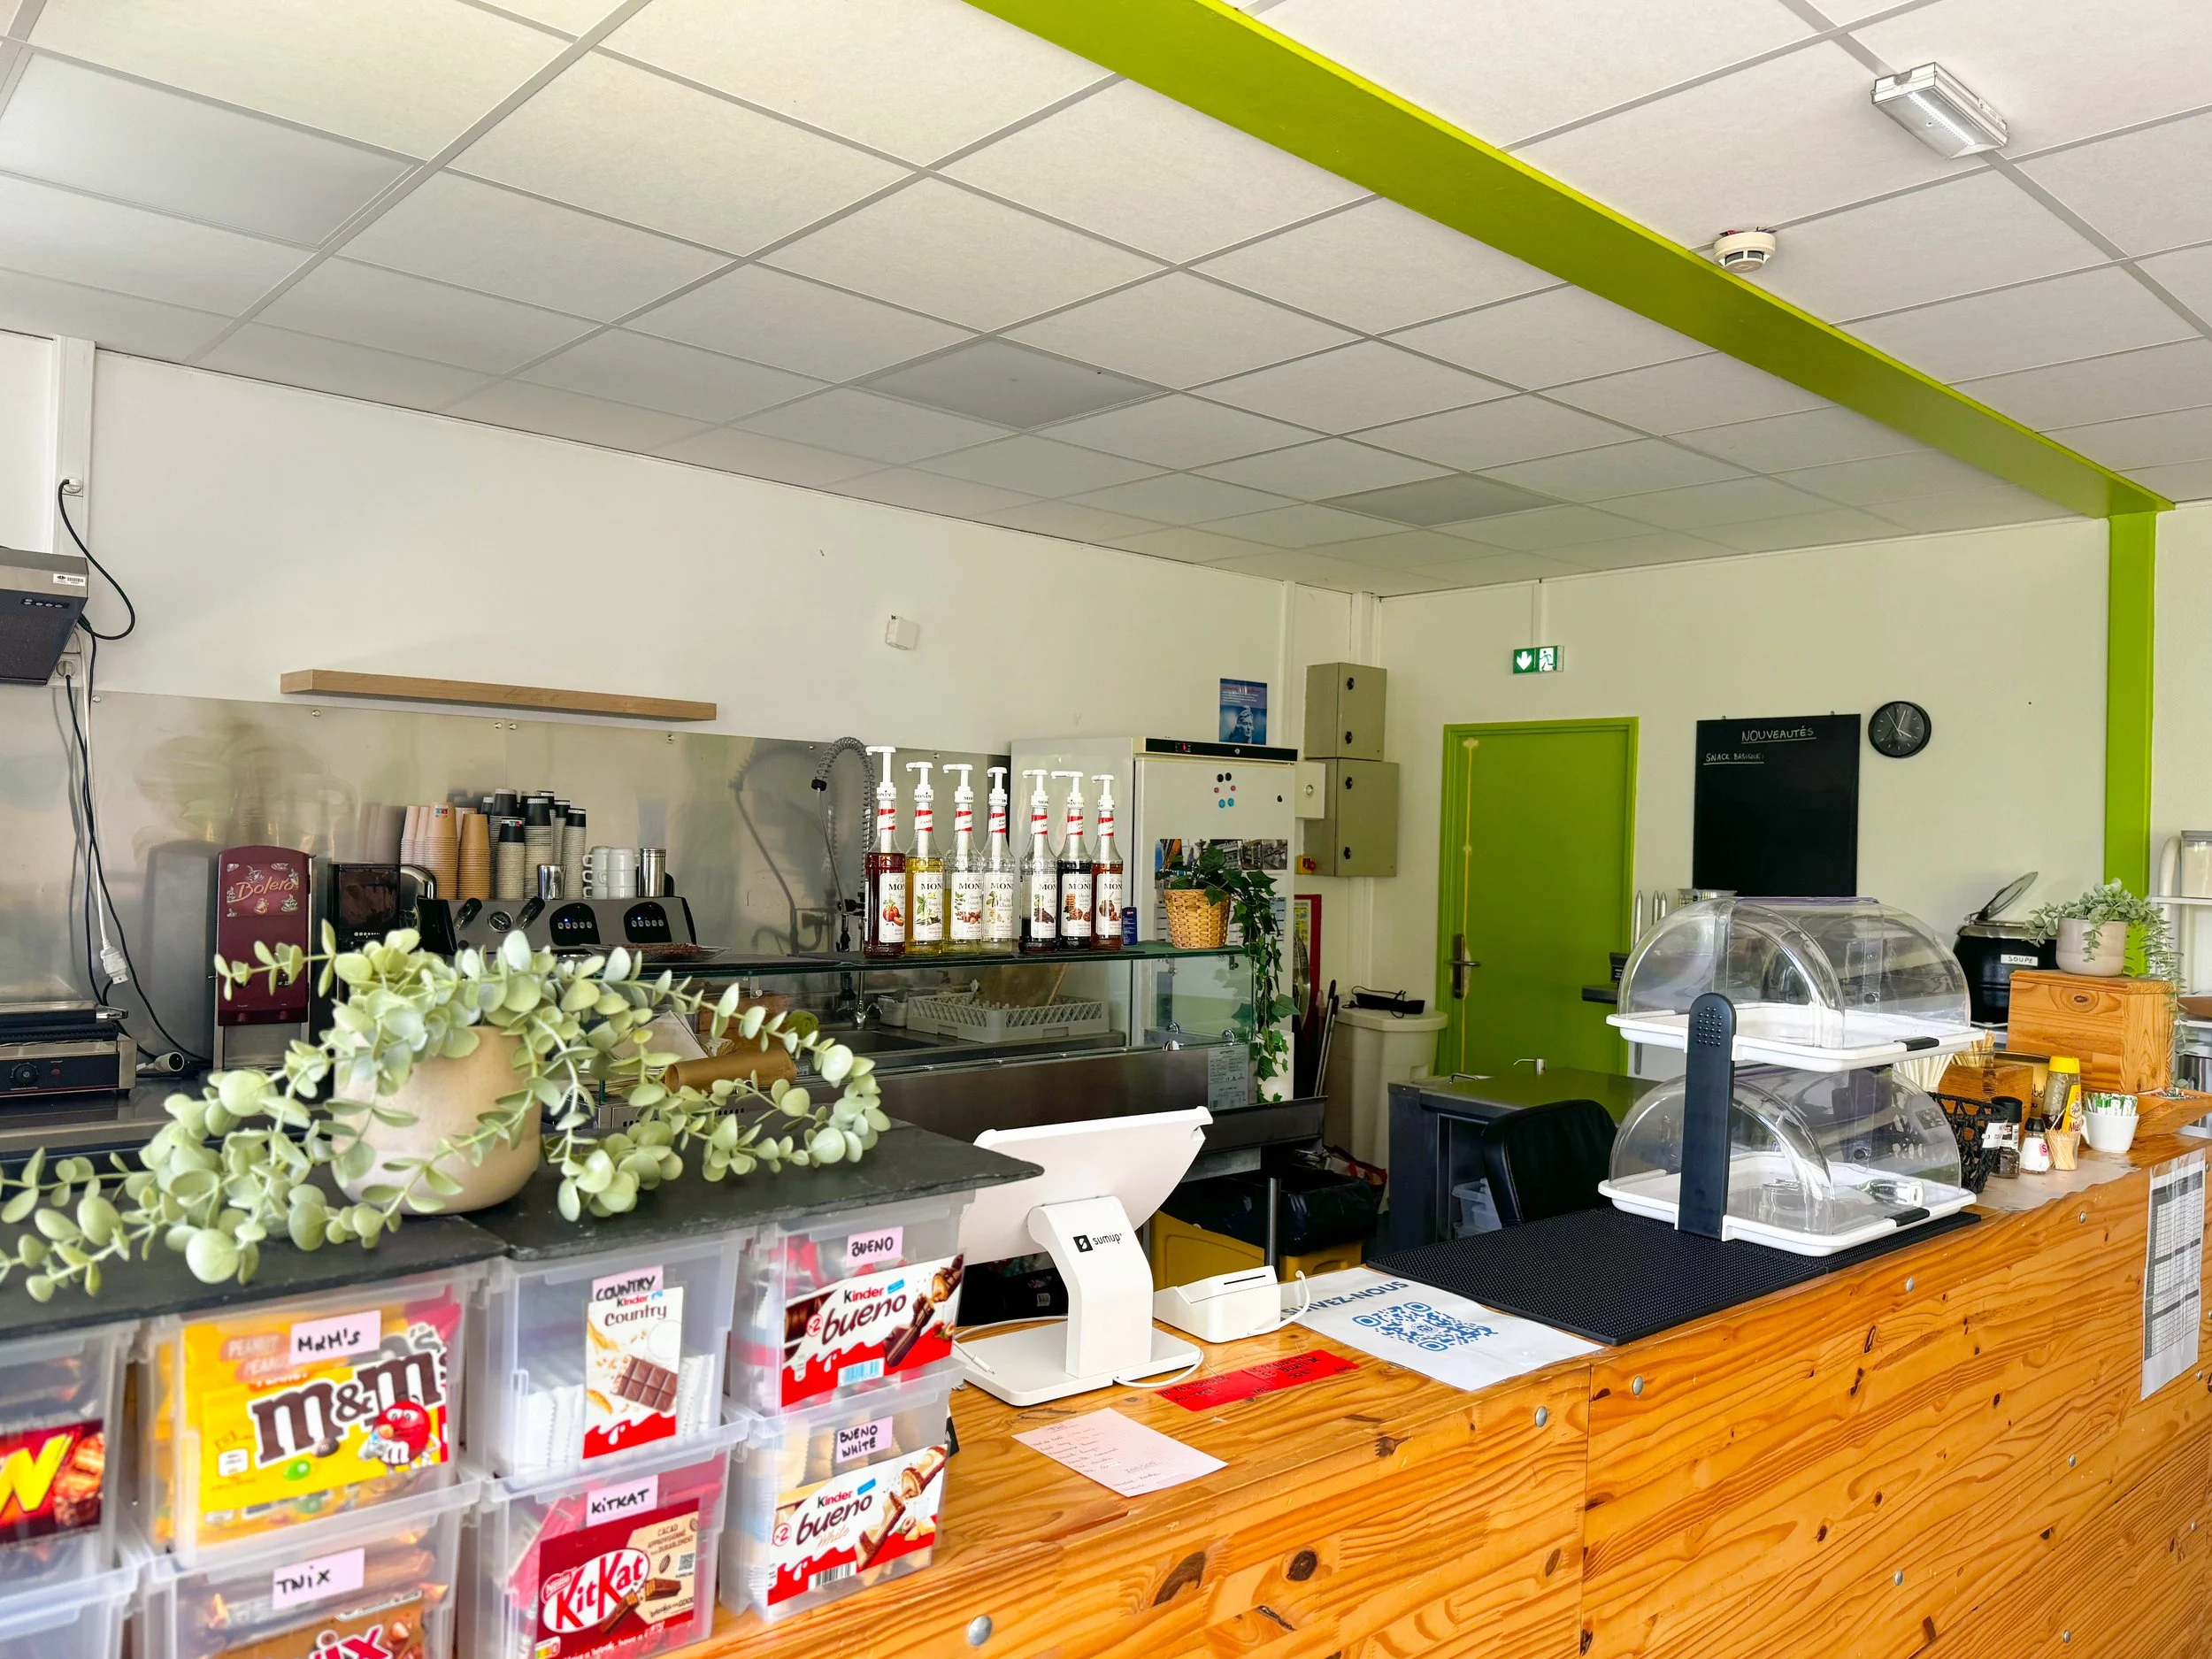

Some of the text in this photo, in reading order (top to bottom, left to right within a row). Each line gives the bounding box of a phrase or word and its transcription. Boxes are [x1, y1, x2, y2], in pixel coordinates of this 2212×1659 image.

[1741, 726, 1815, 742] NOUVEAUTÉS
[227, 876, 296, 903] Bolero
[851, 1236, 894, 1257] BUENO
[1092, 1233, 1122, 1246] sumup
[595, 1275, 656, 1302] COUNTRY
[604, 1304, 667, 1326] Country
[822, 1294, 907, 1345] bueno
[840, 1425, 878, 1443] BUENO
[796, 1494, 872, 1546] bueno
[554, 1551, 644, 1631] KitKat
